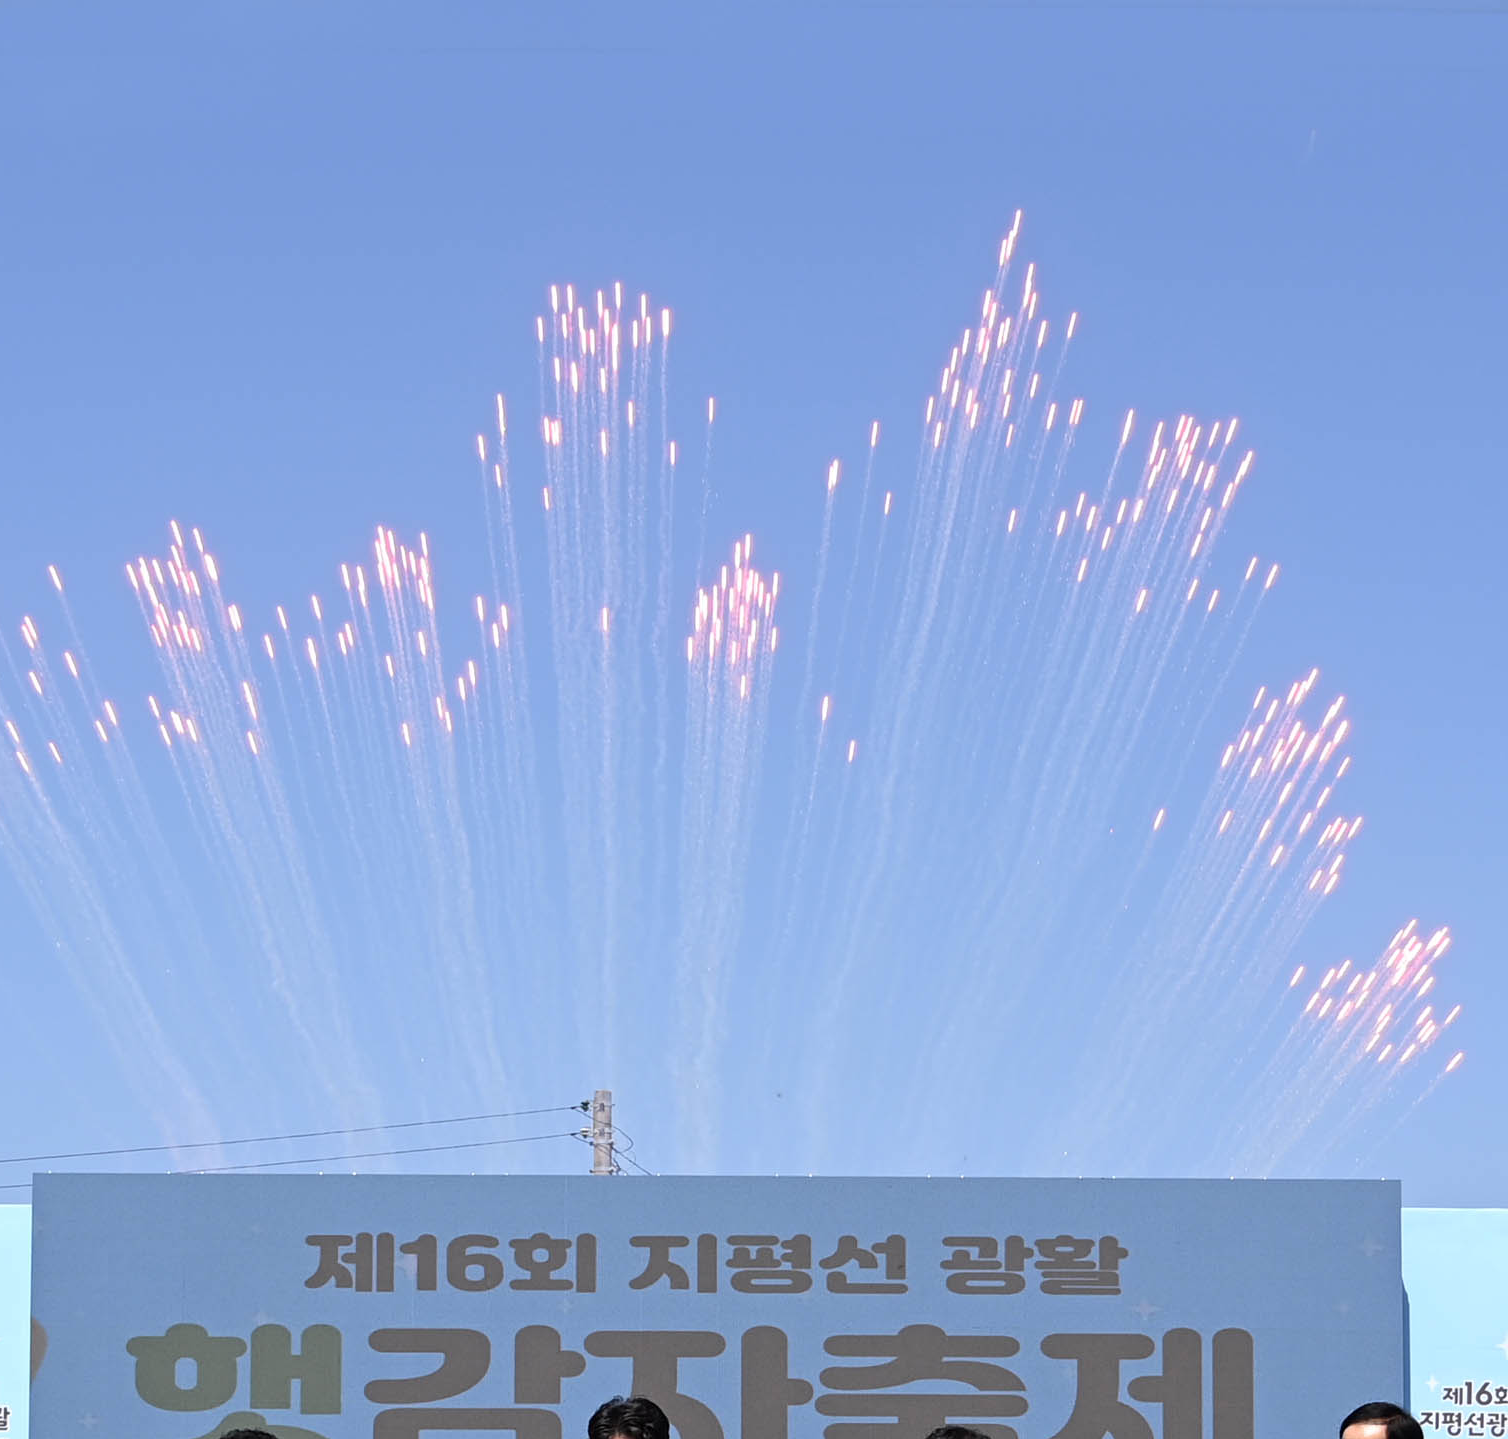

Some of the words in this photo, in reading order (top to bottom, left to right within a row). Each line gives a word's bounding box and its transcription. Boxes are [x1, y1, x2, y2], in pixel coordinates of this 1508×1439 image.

[304, 1232, 597, 1294] 제16회
[629, 1232, 909, 1296] 지평선
[939, 1233, 1129, 1297] 광활
